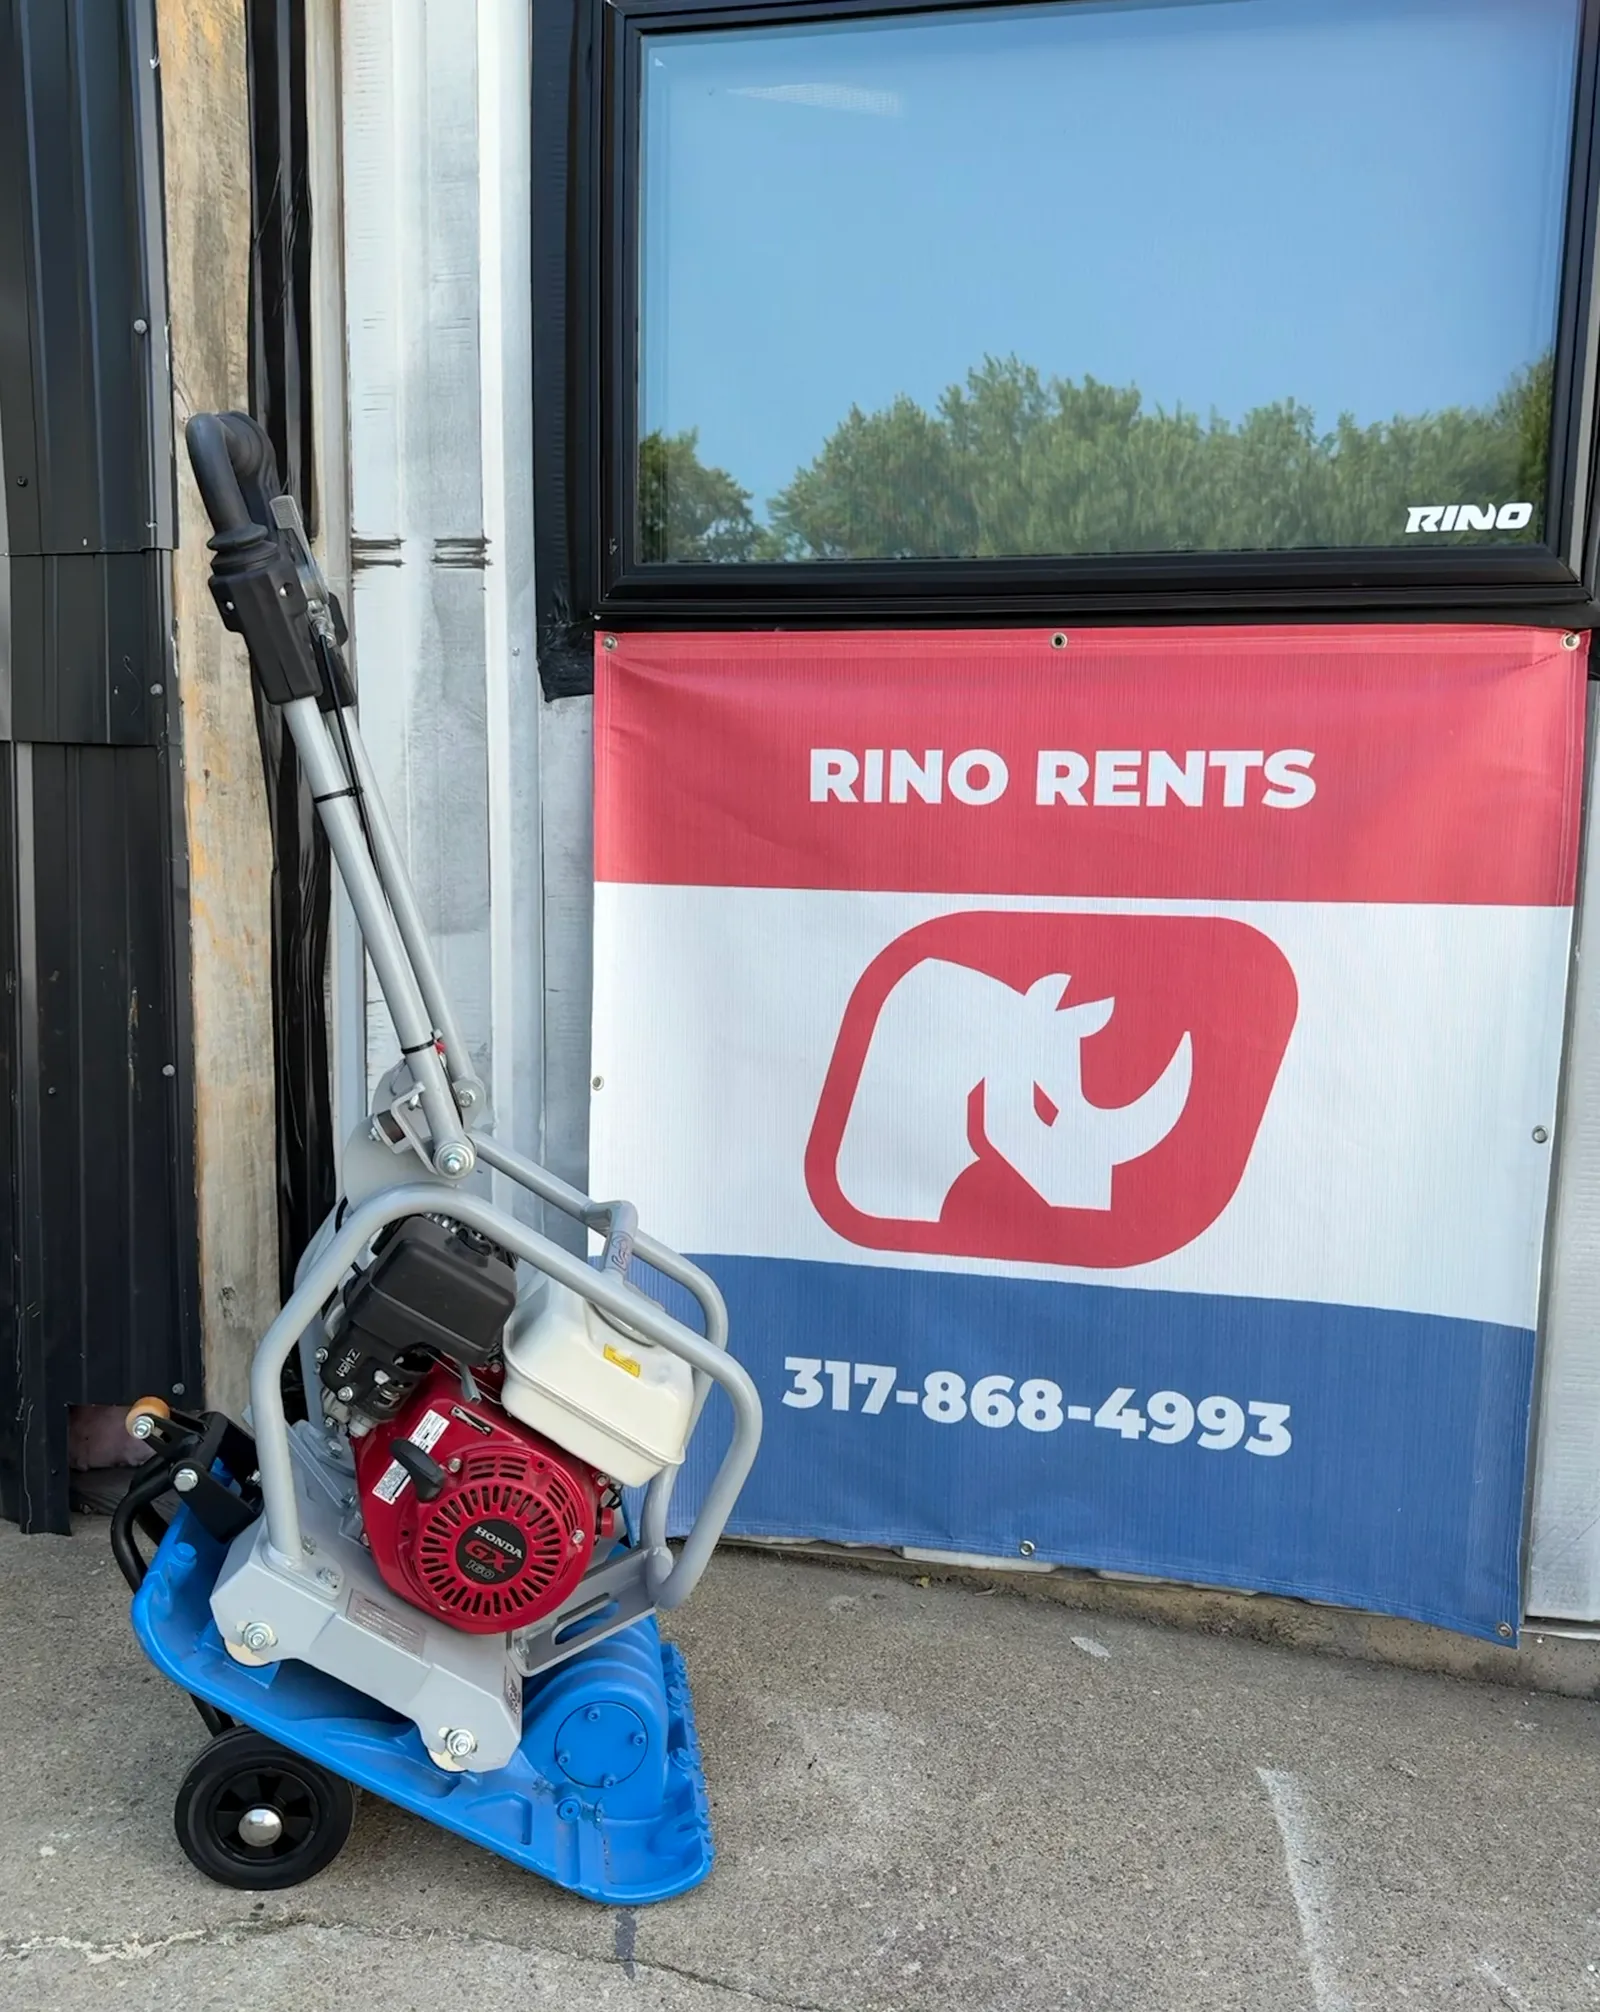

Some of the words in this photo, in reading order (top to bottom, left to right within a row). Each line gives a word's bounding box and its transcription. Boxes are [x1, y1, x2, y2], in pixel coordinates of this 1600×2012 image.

[1405, 502, 1533, 533] RINO
[809, 748, 1009, 805] RINO
[1035, 749, 1317, 809] RENTS
[782, 1356, 1293, 1457] 317-868-4993
[465, 1541, 515, 1573] GX
[474, 1526, 522, 1559] HONDA
